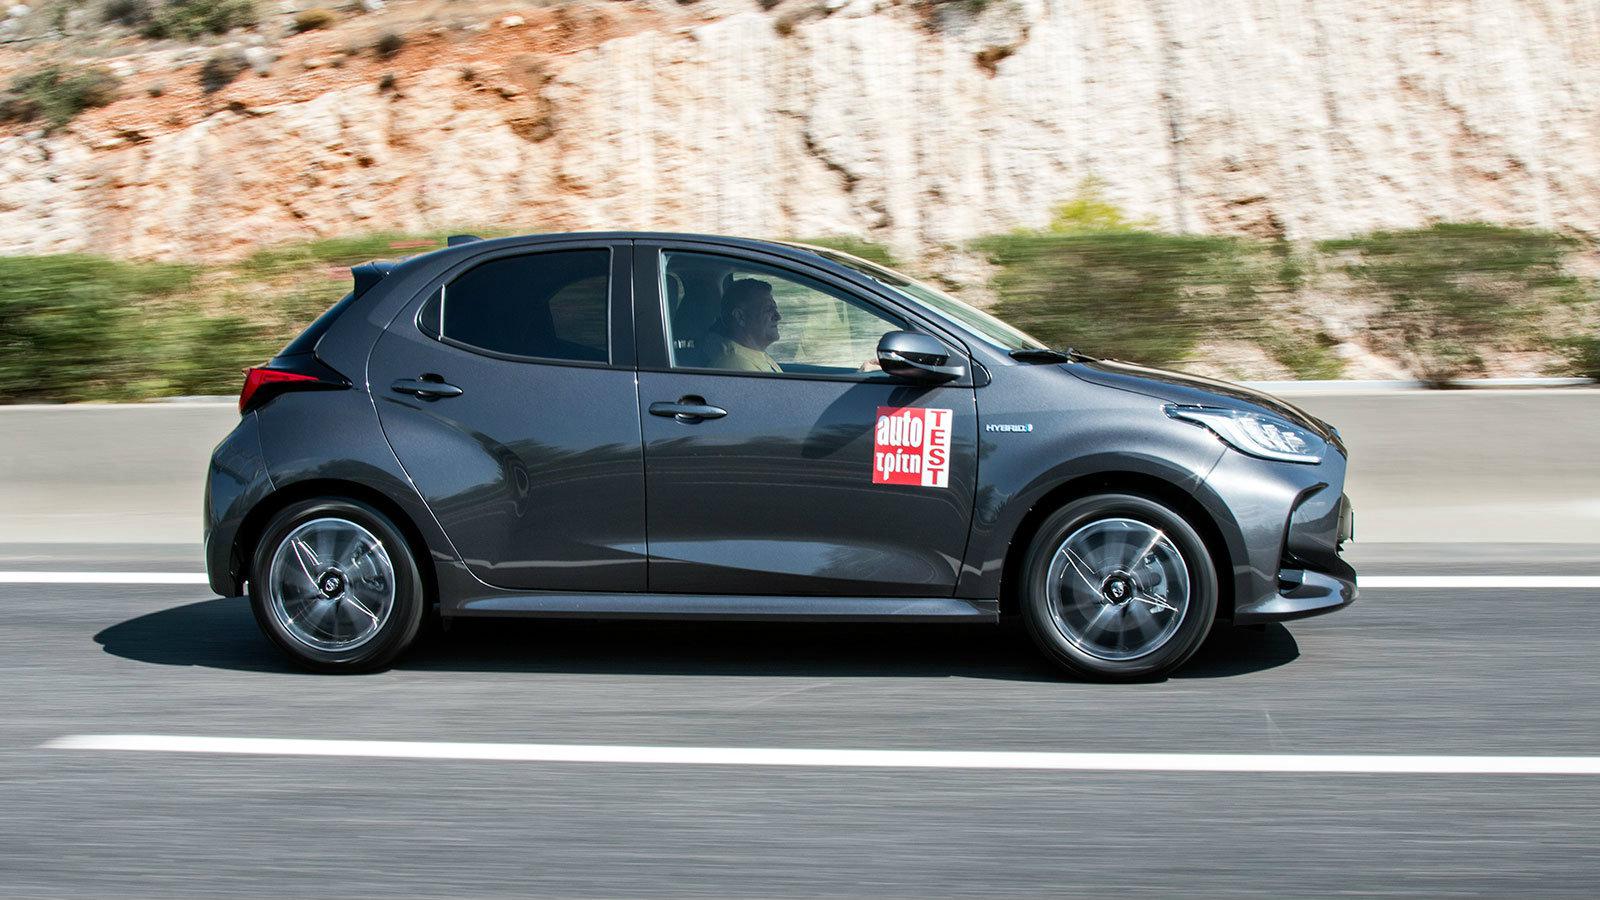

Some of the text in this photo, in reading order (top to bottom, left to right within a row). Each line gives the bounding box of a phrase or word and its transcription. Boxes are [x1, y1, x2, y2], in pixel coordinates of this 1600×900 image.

[877, 411, 923, 448] auto
[986, 424, 1024, 432] HYBRID
[875, 448, 921, 480] τρίτη
[927, 410, 947, 485] TEST
